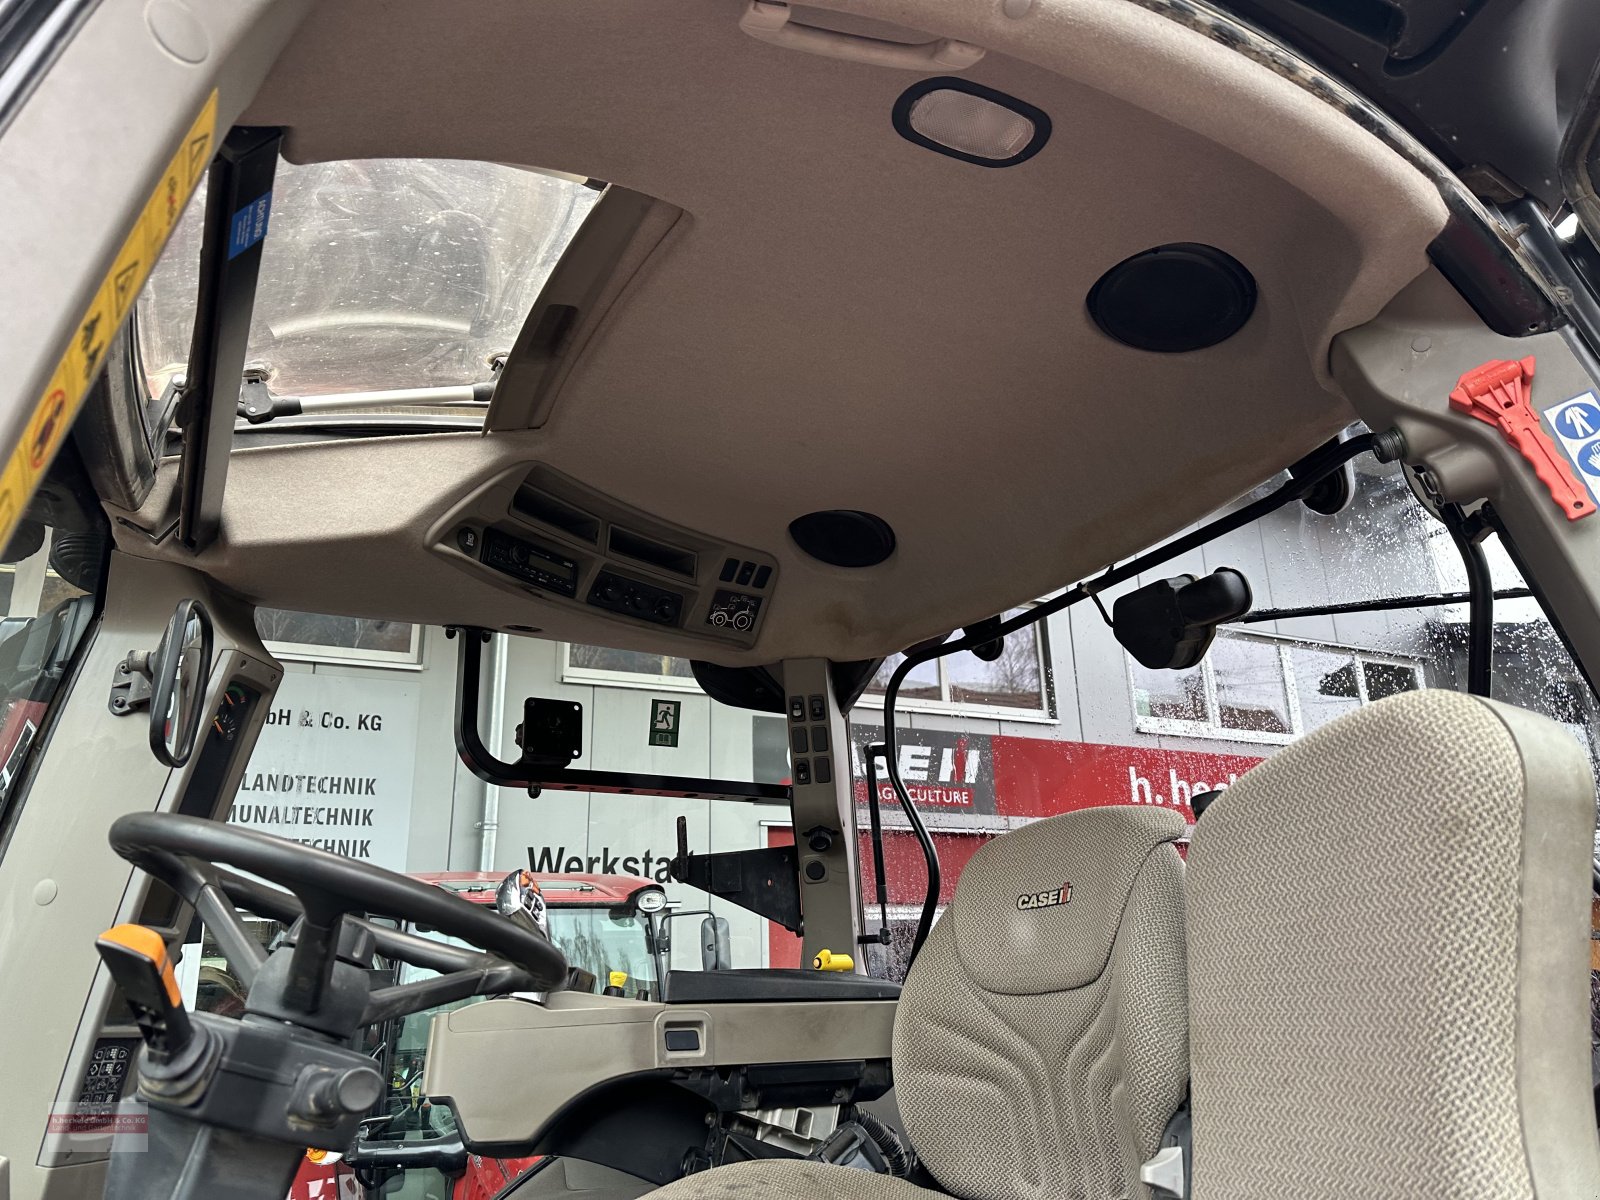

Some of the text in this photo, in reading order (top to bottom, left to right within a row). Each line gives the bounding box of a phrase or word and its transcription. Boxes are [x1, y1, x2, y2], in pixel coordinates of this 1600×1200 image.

[266, 708, 383, 731] bH & Co. KG
[241, 772, 377, 796] LANDTECHNIK
[527, 846, 694, 884] Werksta
